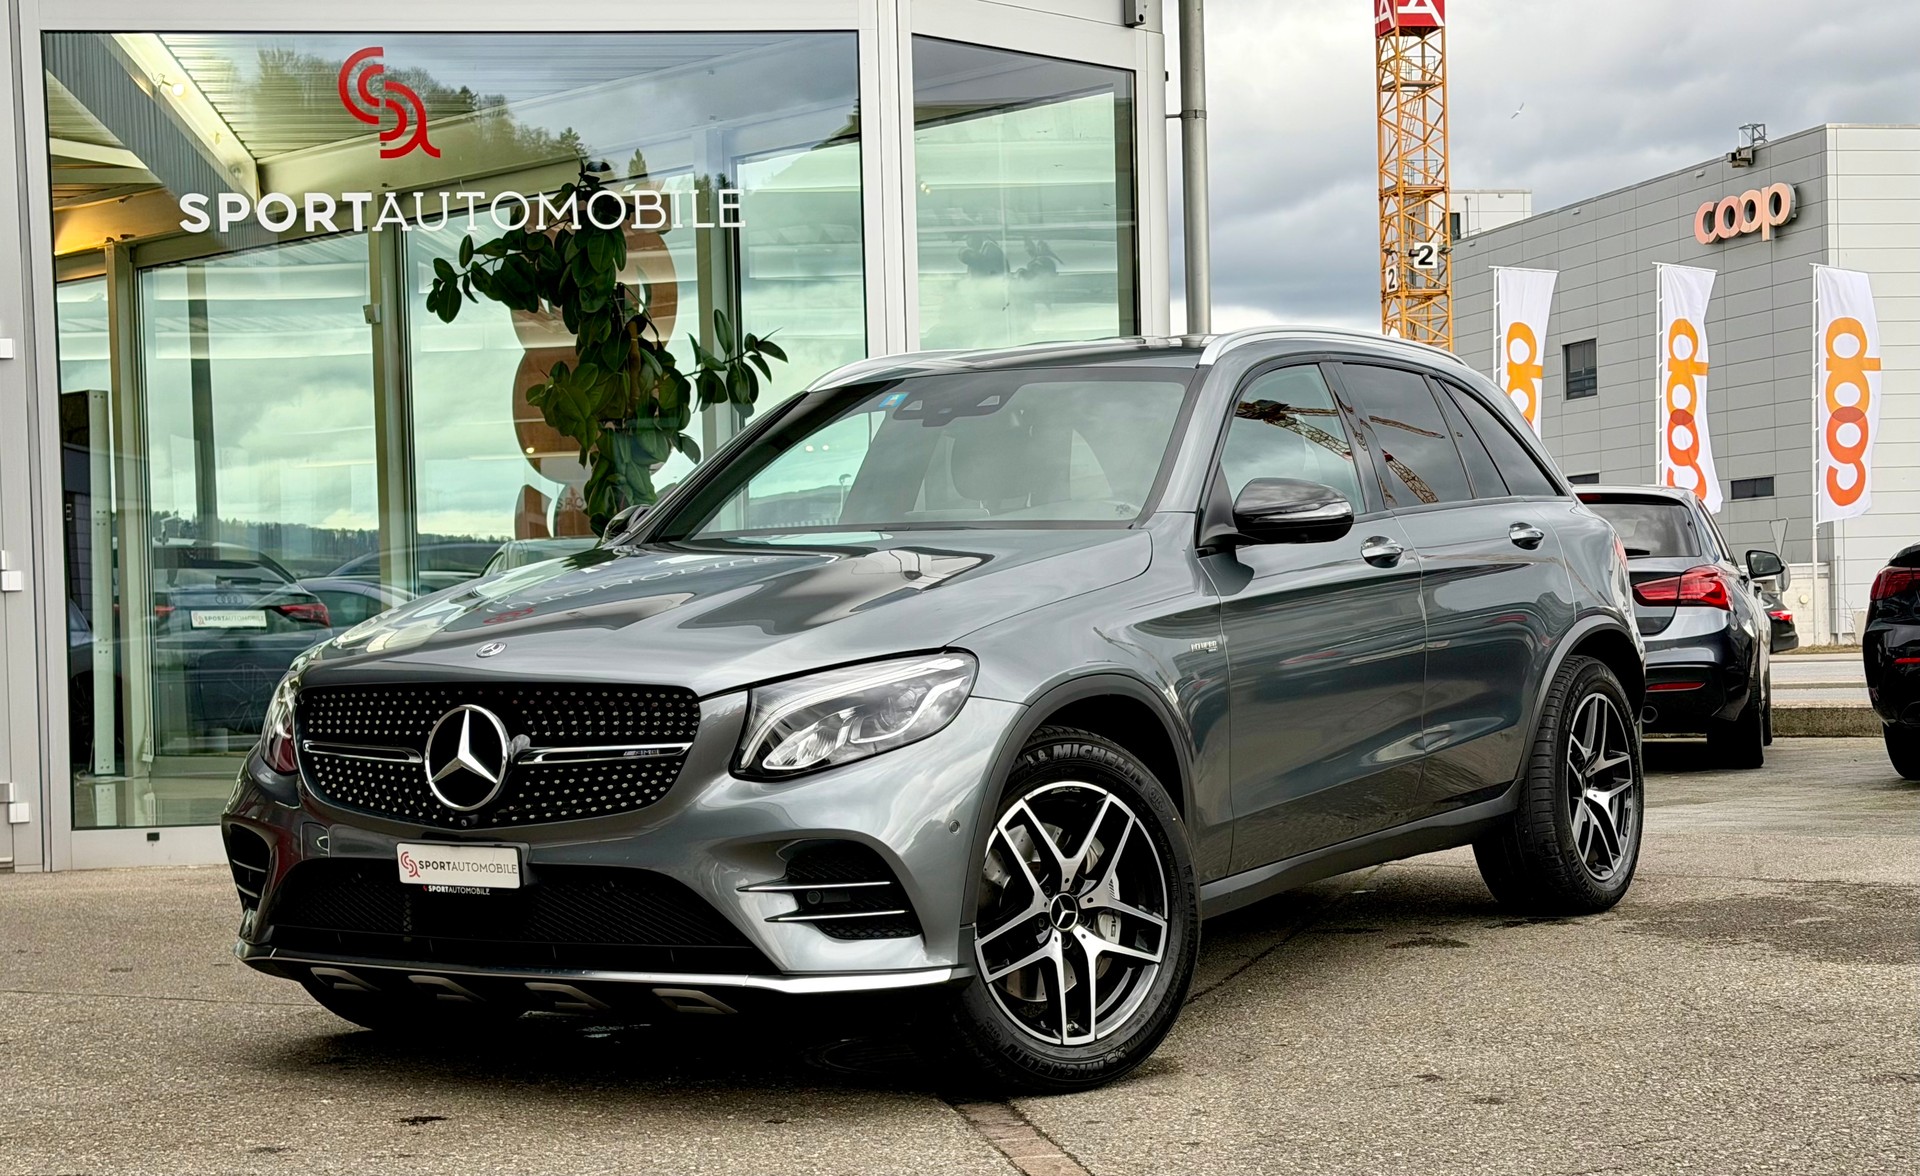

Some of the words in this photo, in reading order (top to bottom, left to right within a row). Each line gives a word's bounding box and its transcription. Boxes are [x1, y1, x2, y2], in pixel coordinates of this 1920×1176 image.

[179, 189, 746, 232] SPORTAUTOMOBILE
[1694, 182, 1794, 244] coop
[1417, 245, 1433, 265] 2
[1388, 268, 1395, 289] 2
[1826, 317, 1881, 506] coop
[1053, 744, 1145, 787] MICHELIN
[419, 861, 517, 874] SPORTAUTOMOBILE
[428, 885, 490, 895] SPORTAUTOMOBILE
